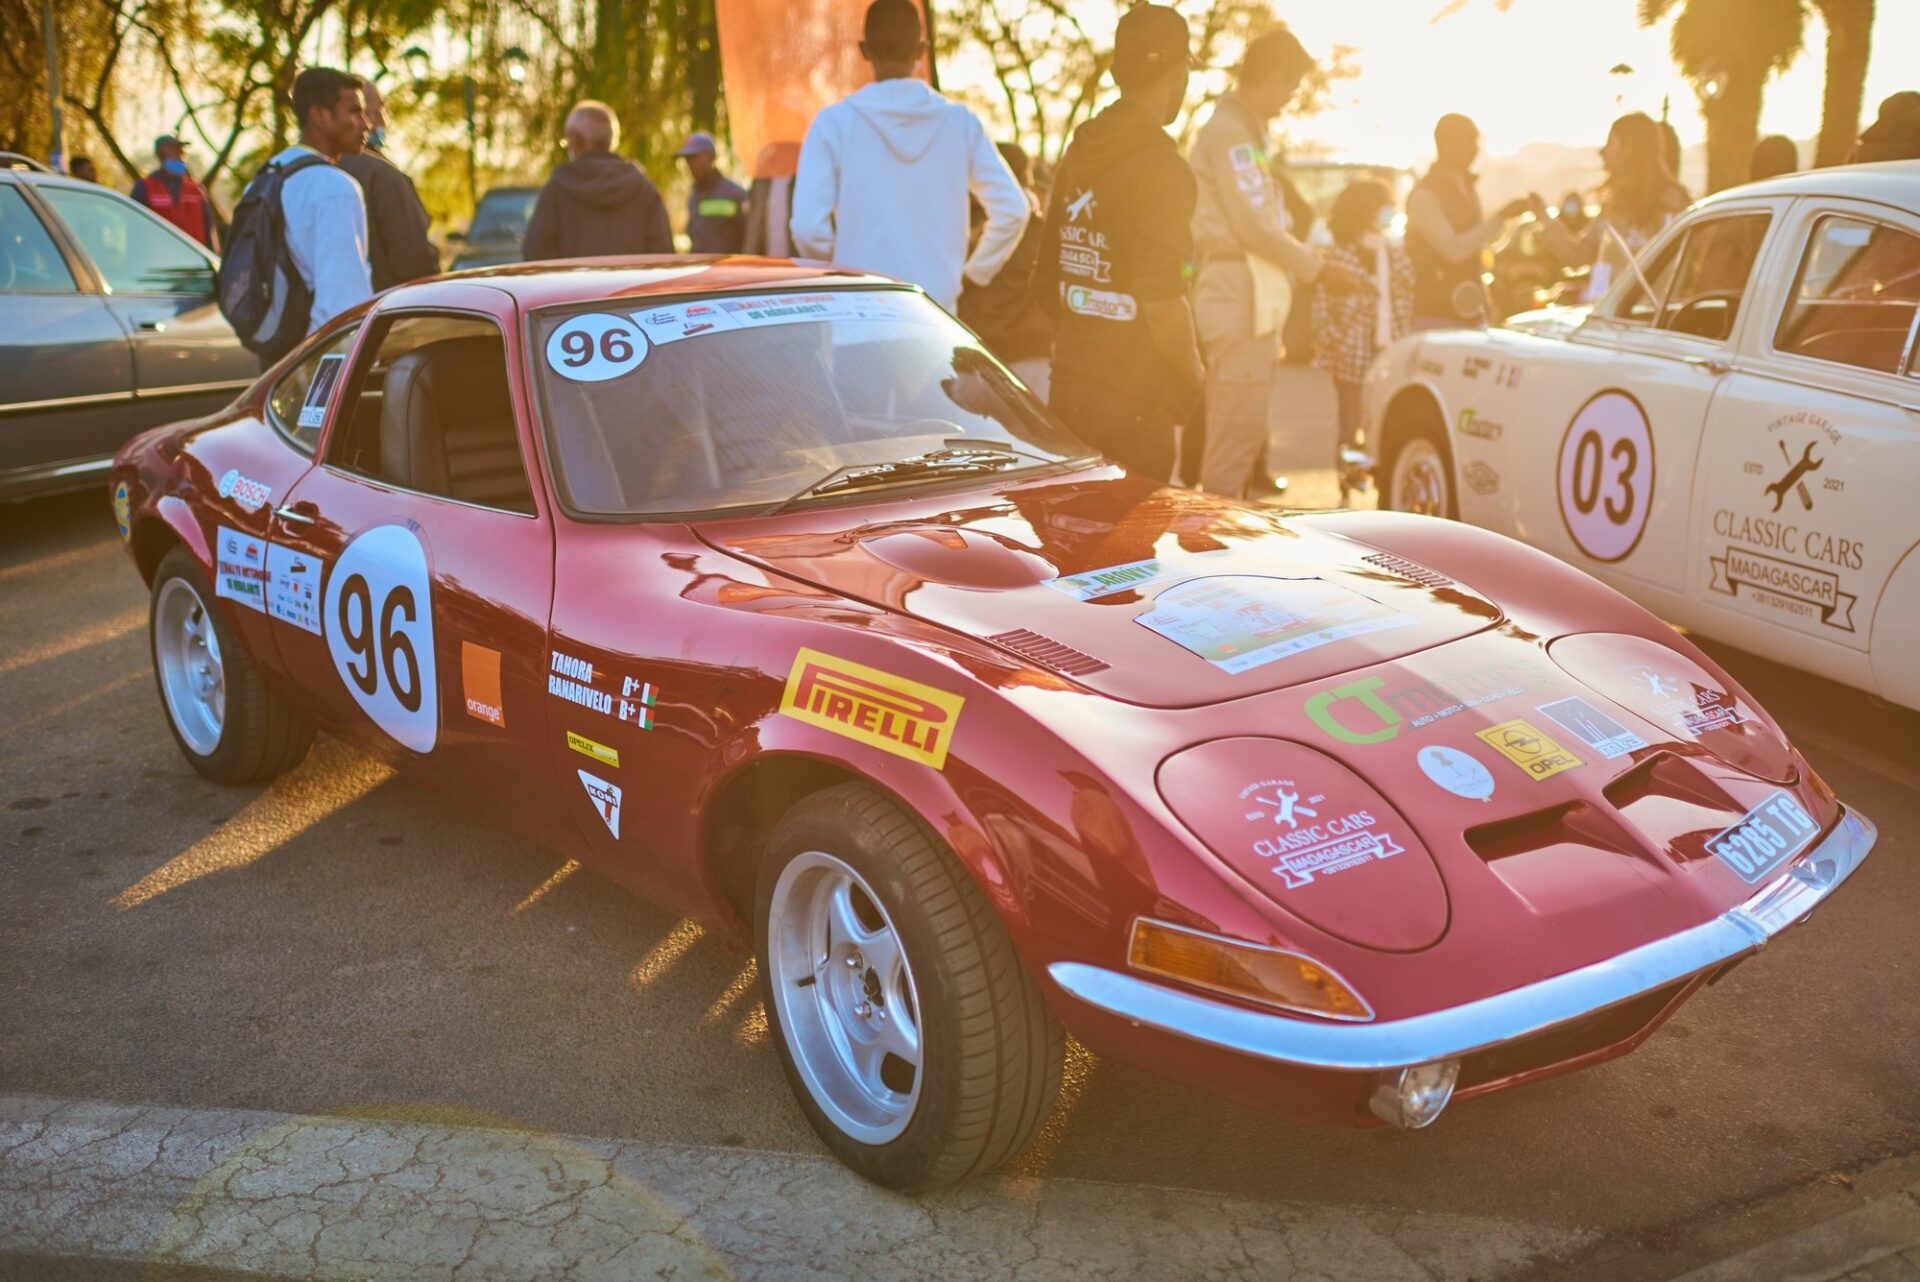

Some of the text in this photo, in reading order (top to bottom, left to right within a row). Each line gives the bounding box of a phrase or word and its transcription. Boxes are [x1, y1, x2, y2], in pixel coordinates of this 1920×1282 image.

[561, 328, 634, 368] 96
[1767, 412, 1842, 445] VINTAGE GARAGE
[233, 478, 267, 503] BOSCH
[1573, 429, 1637, 526] 03
[1823, 477, 1845, 491] 2021
[1713, 509, 1864, 570] CLASSIC CARS
[1730, 557, 1833, 601] MADAGASCAR
[338, 573, 422, 712] 96
[467, 698, 501, 722] orange
[548, 674, 612, 715] RANARIVELO
[793, 662, 948, 754] PIRELLI
[1530, 754, 1576, 774] OPEL
[588, 784, 617, 808] KONI
[1253, 810, 1376, 857] CLASSIC CARS
[1716, 797, 1813, 874] 6285 TG
[1289, 837, 1376, 872] MADAGASCAR
